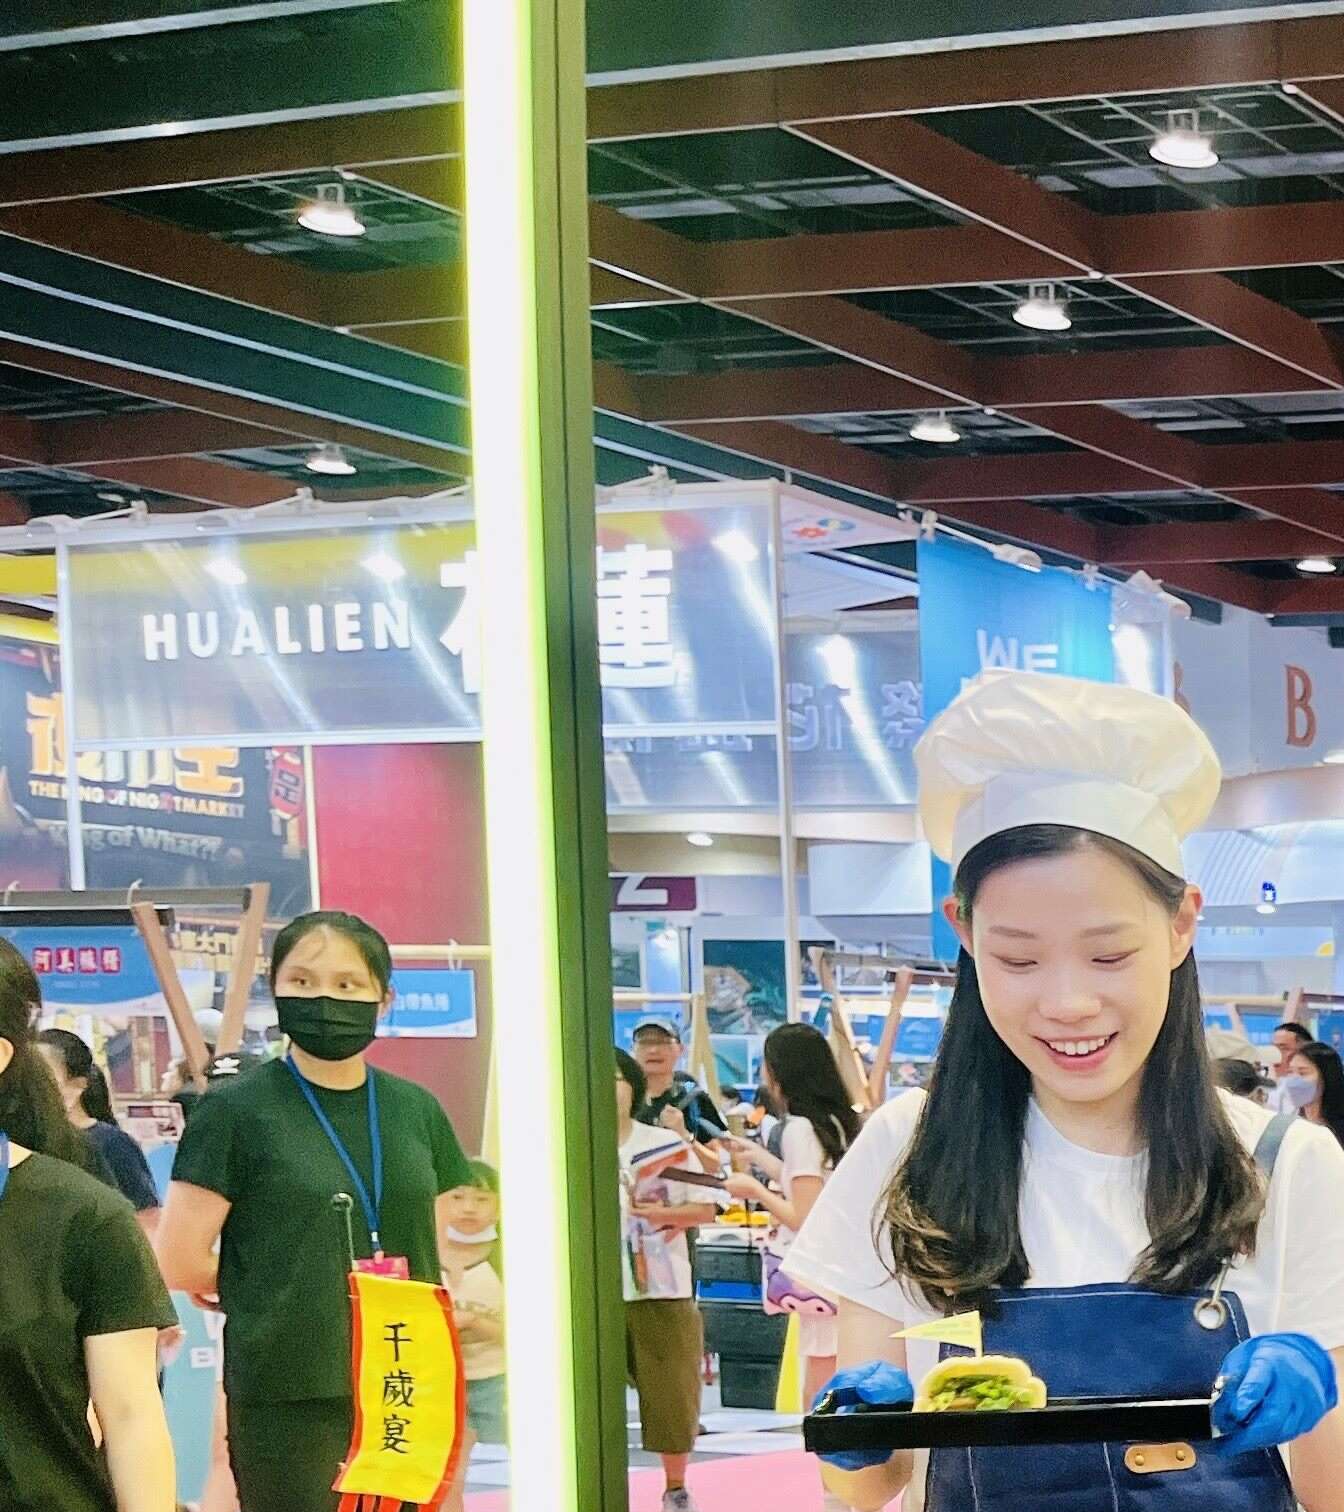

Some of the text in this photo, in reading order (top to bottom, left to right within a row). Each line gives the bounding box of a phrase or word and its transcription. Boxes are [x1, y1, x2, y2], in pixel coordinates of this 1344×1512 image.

[143, 601, 411, 661] HUALIEN
[1285, 664, 1316, 747] B
[379, 1322, 417, 1454] 千歲宴
